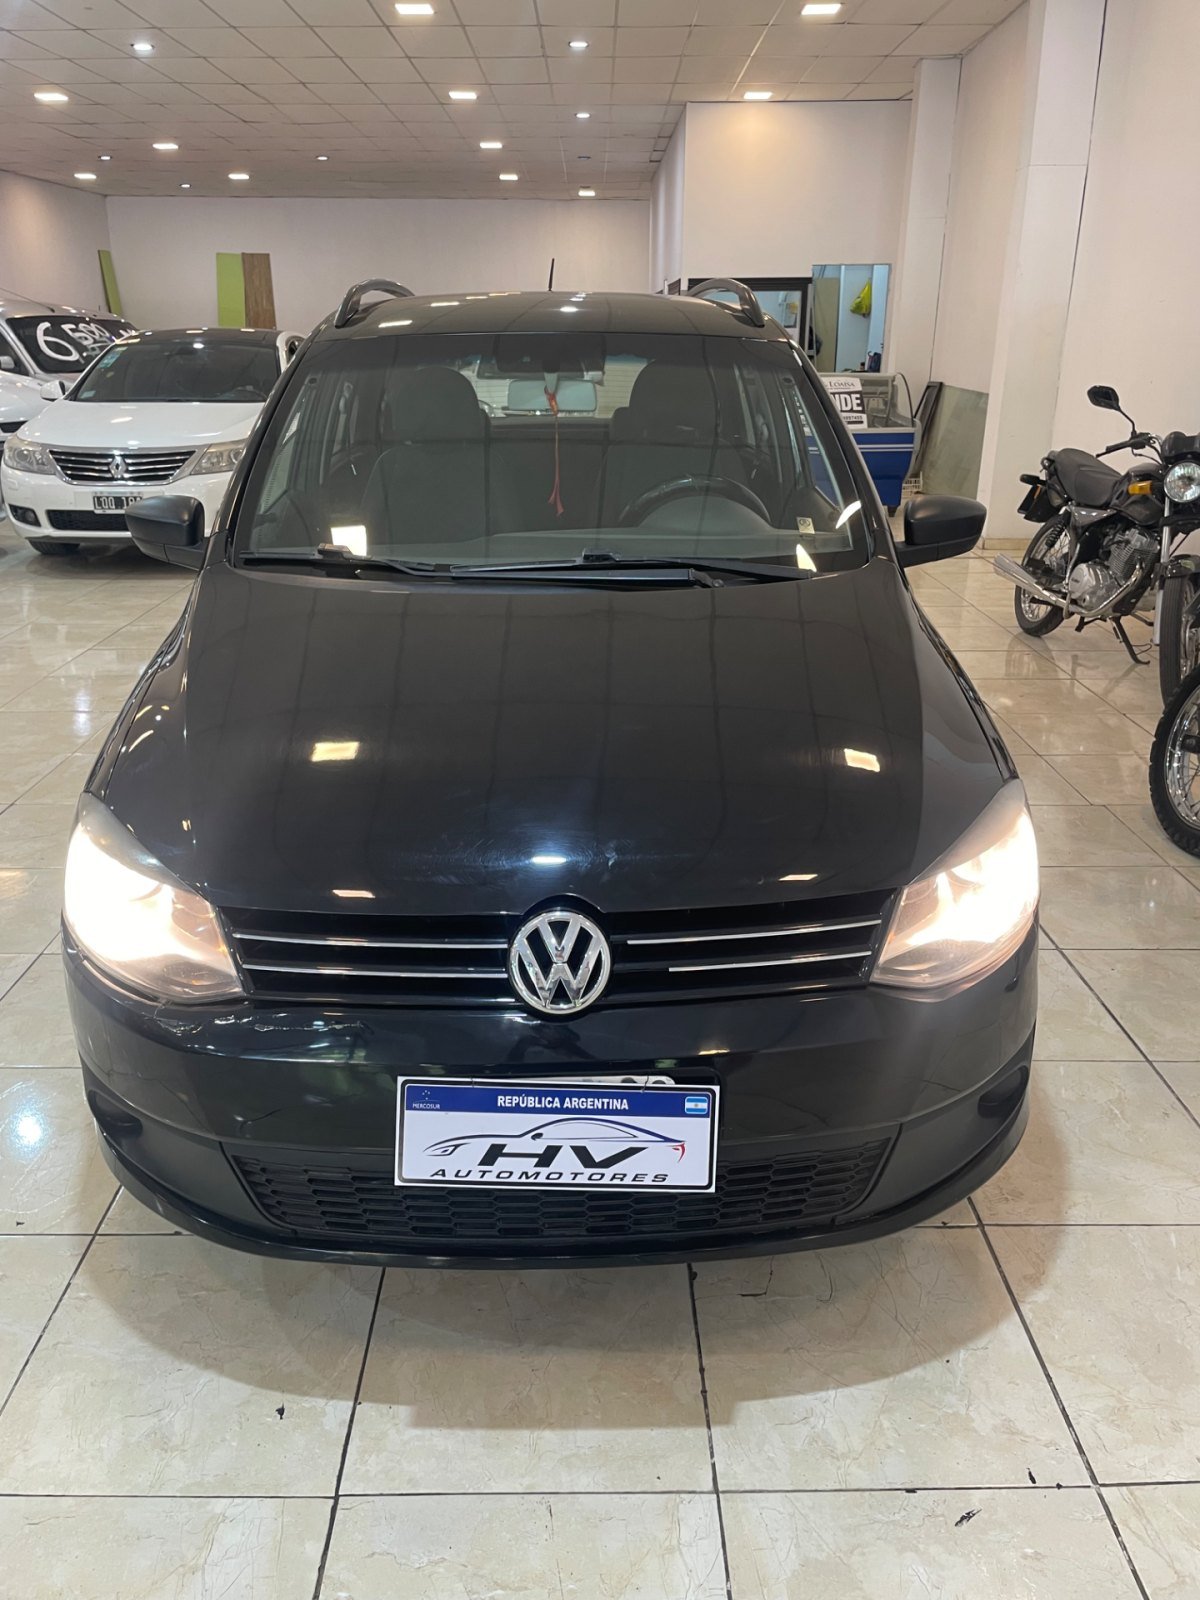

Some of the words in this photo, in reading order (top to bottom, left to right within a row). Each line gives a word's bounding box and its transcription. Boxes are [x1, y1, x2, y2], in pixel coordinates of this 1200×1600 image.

[412, 1102, 441, 1110] MERCOSUR
[497, 1093, 561, 1109] REPÚBLICA
[563, 1096, 629, 1110] ARGENTINA
[477, 1143, 649, 1169] HV
[429, 1168, 669, 1183] AUTOMOTORES
